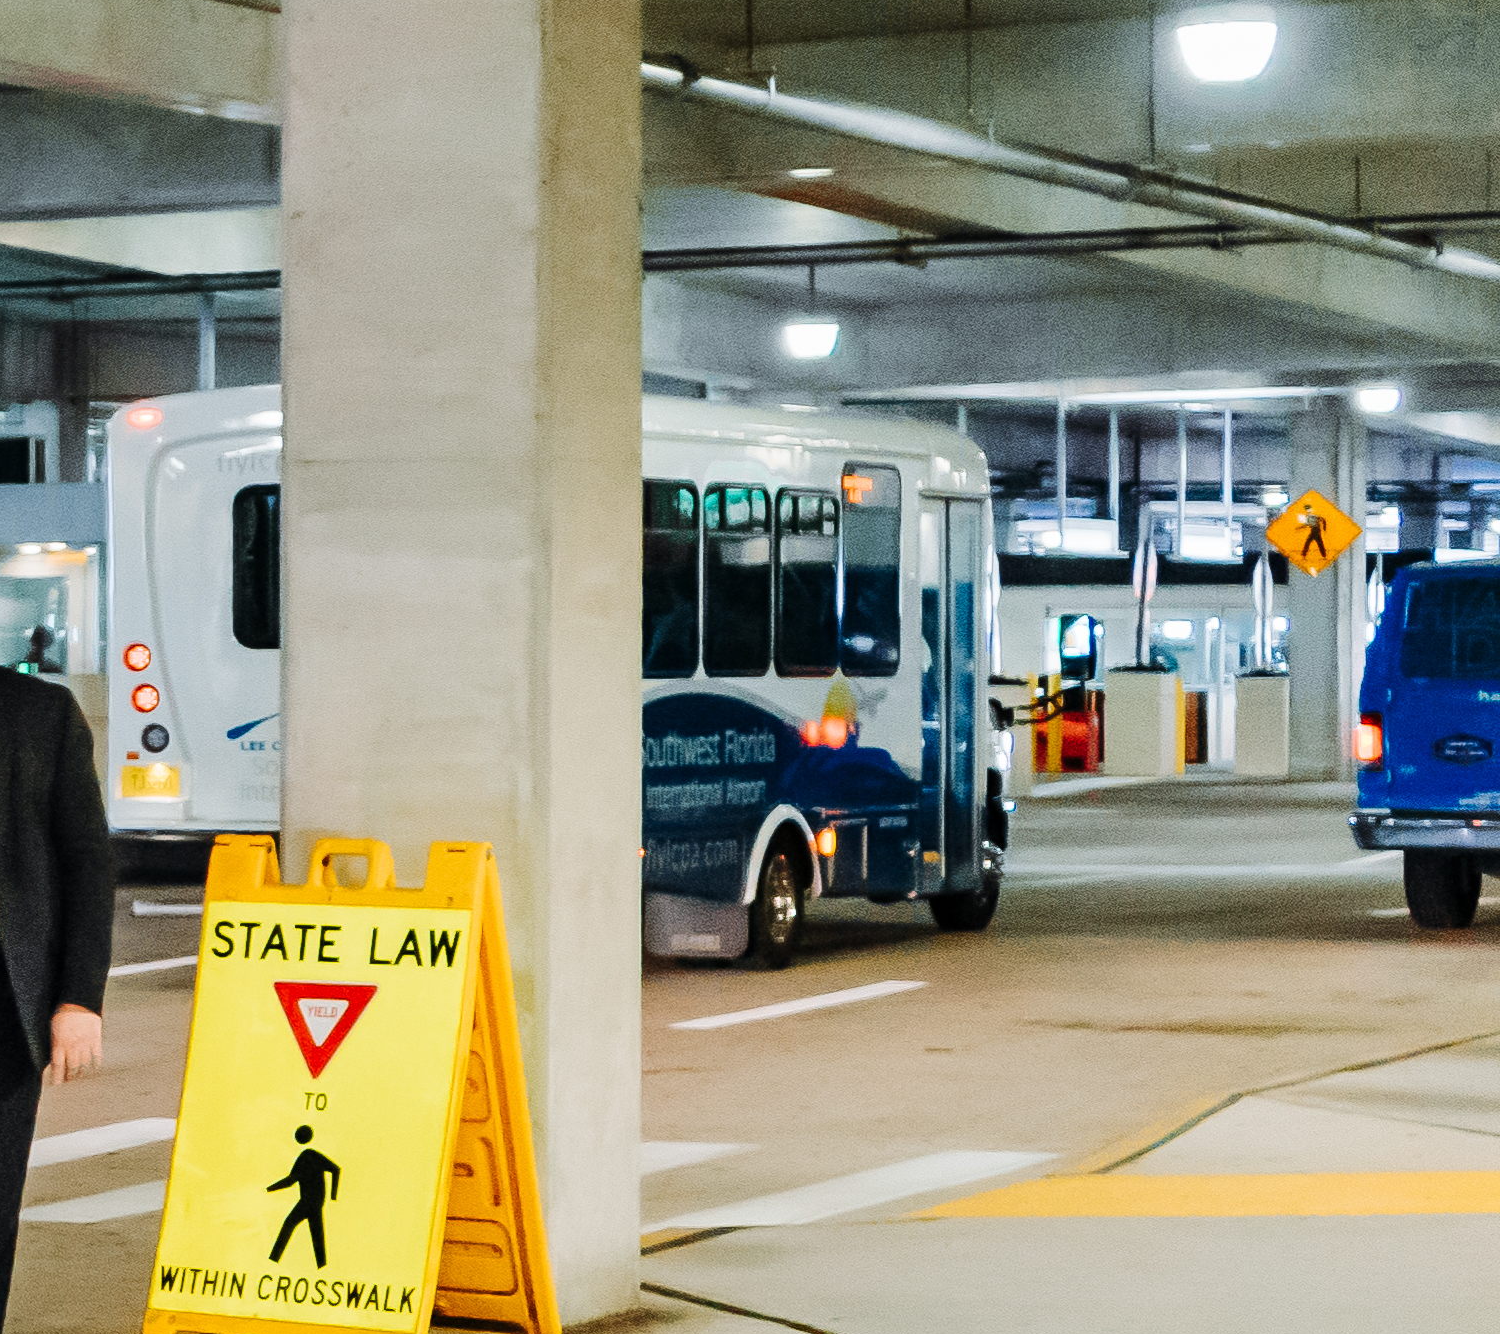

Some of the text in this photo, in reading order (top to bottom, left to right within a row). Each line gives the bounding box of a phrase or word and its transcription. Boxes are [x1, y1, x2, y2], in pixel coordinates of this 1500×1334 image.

[240, 740, 267, 752] LEE
[642, 727, 776, 767] outhwest Florida
[211, 920, 462, 968] STATE LAW
[307, 1005, 338, 1019] YIELD
[304, 1091, 328, 1111] TO
[160, 1264, 417, 1315] WITHIN CROSSWALK
